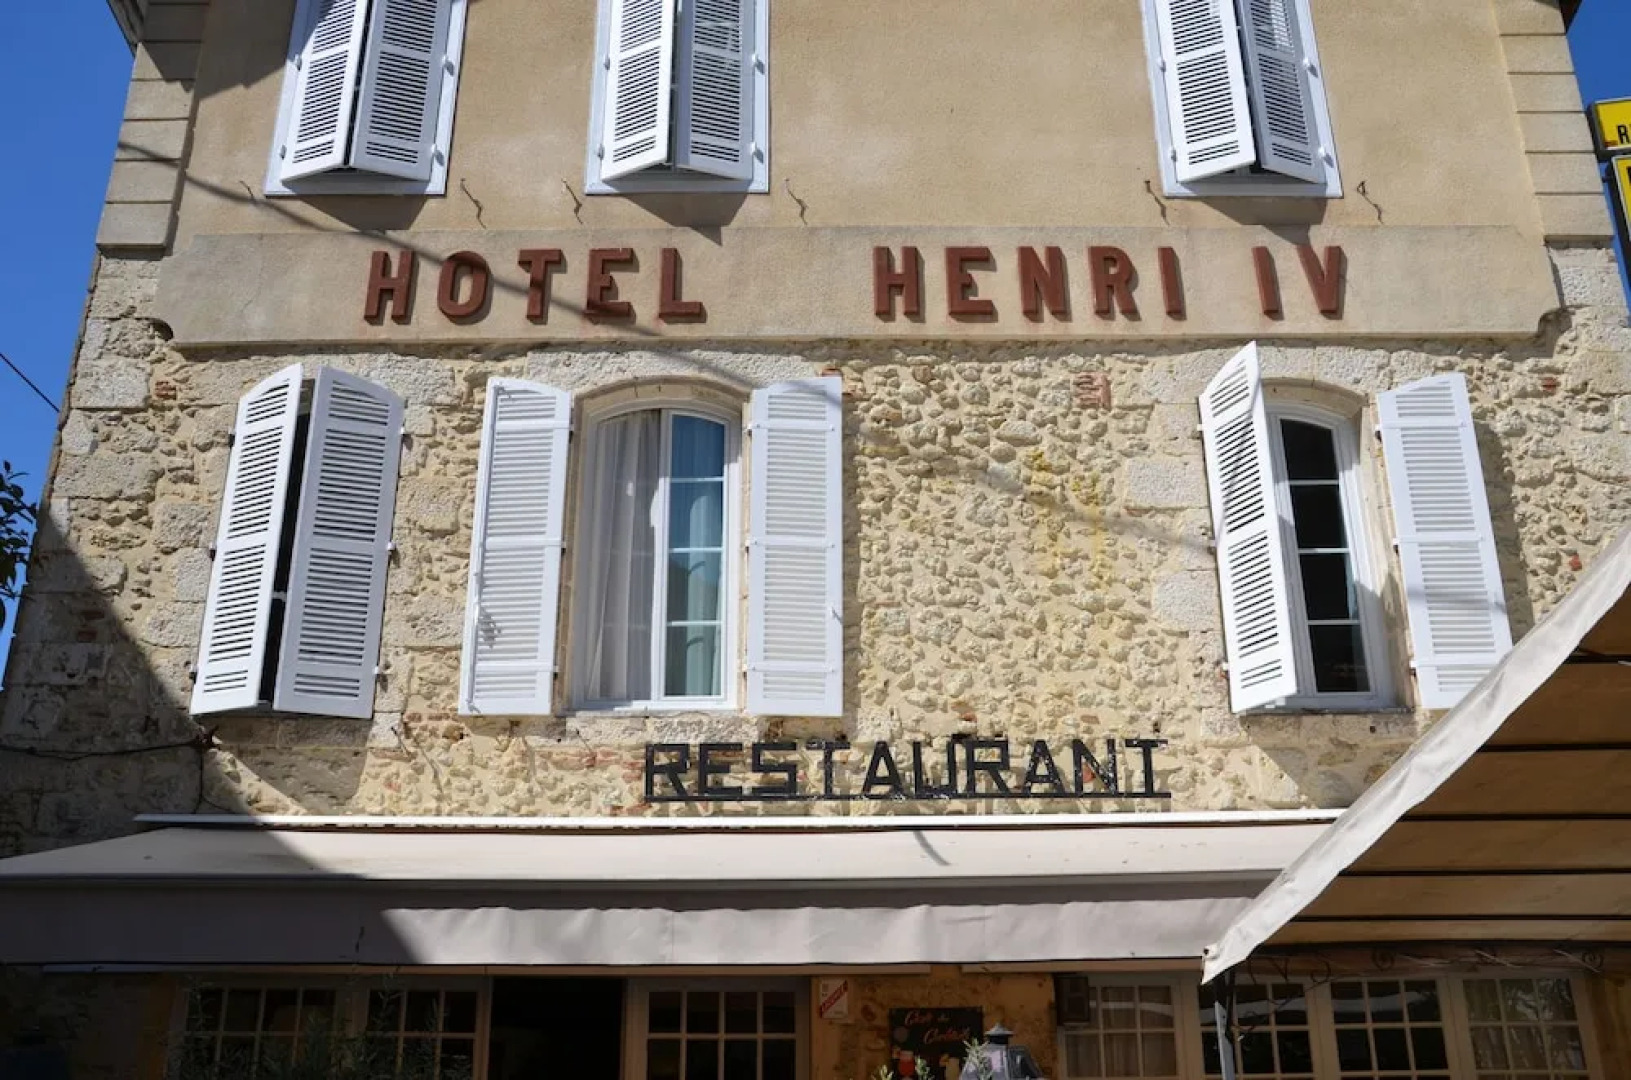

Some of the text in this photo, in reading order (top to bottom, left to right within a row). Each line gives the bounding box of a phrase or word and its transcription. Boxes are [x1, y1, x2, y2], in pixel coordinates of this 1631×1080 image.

[364, 245, 1345, 324] HOTEL HENRI IV
[644, 736, 1171, 801] RESTAURANT
